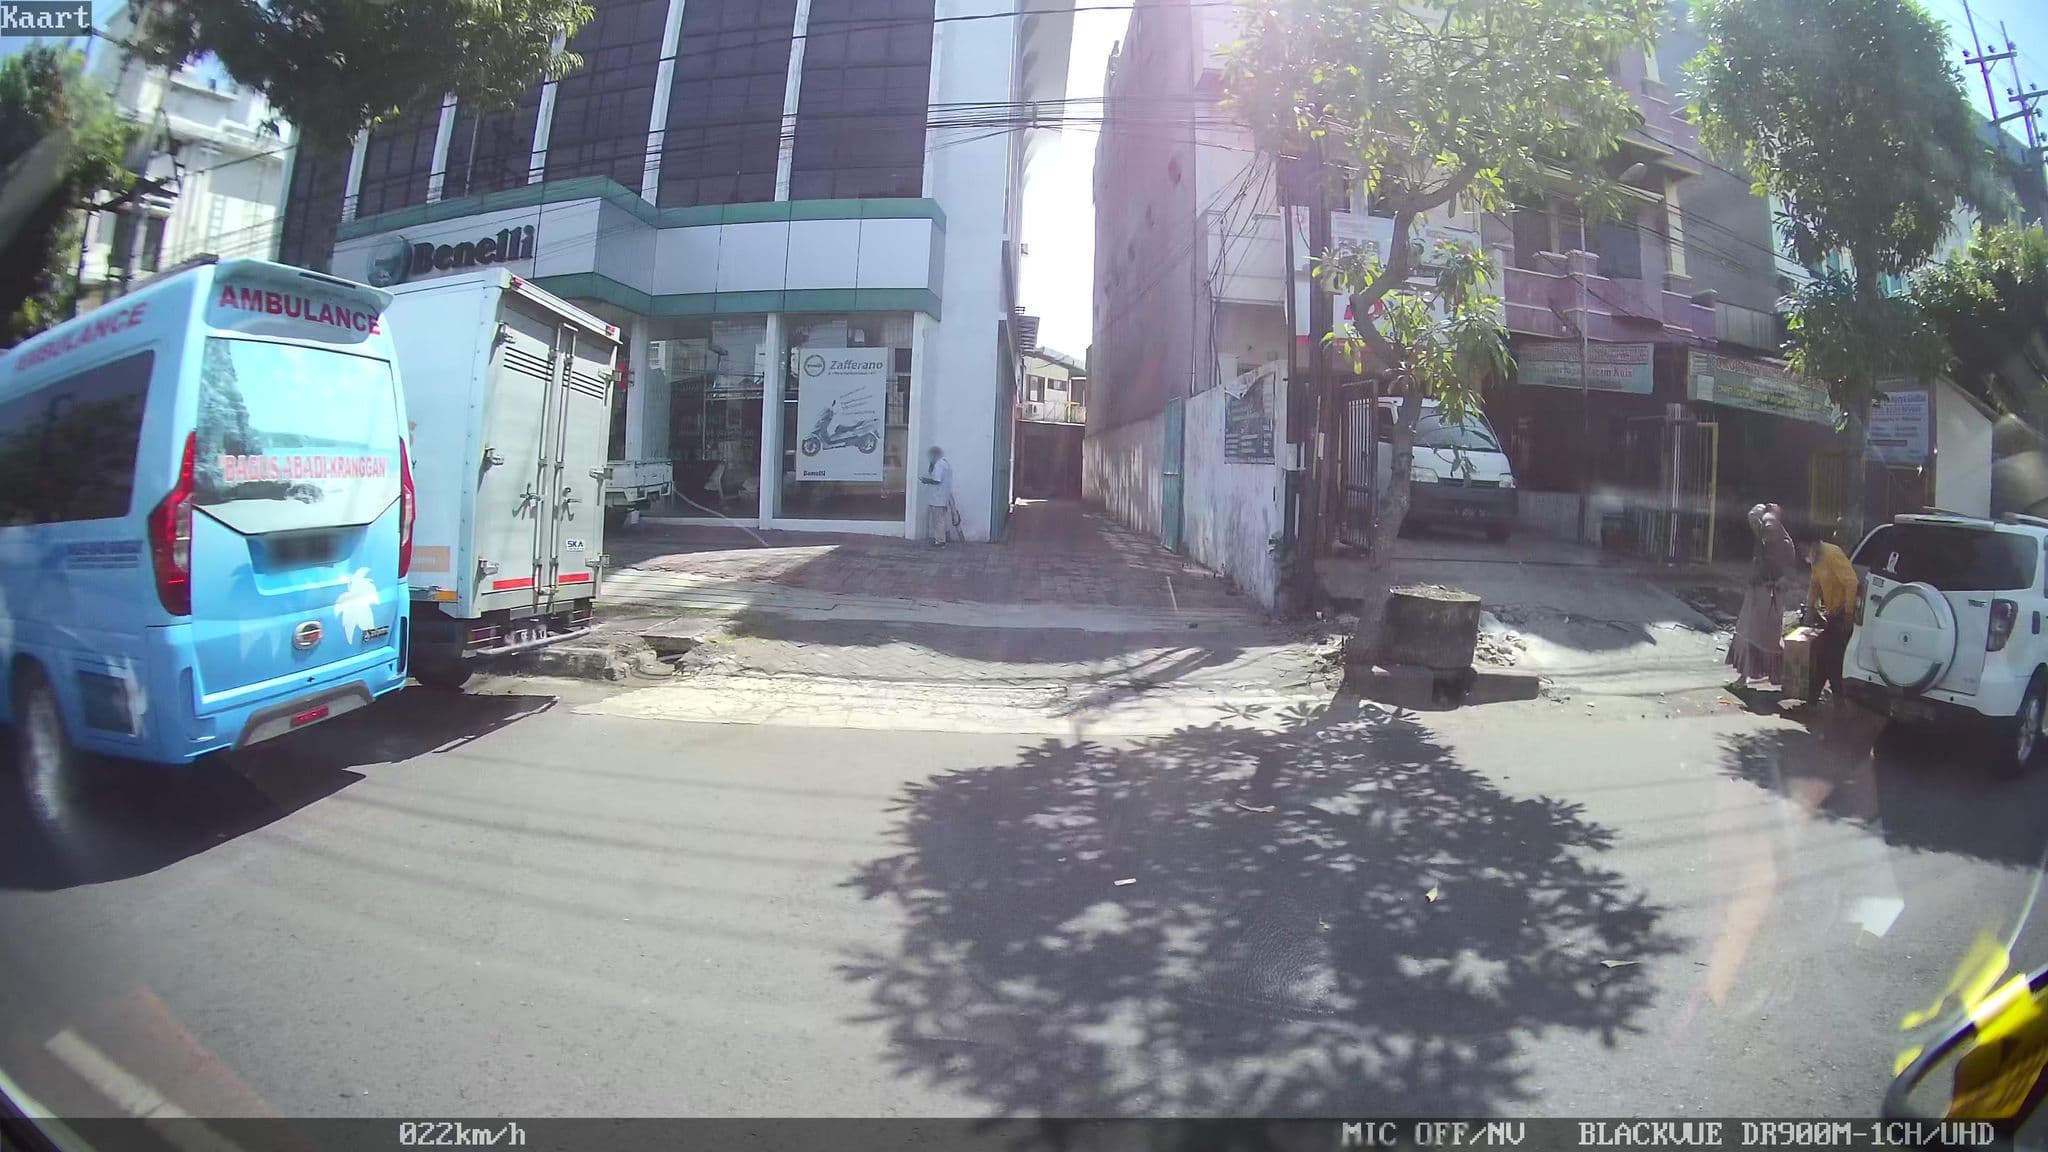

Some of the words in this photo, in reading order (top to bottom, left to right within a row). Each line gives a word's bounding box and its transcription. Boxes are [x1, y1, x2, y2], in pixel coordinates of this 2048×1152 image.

[413, 224, 535, 275] Benelli
[219, 284, 381, 336] AMBULANCE
[830, 359, 883, 370] Zafferano
[567, 540, 584, 548] SKA
